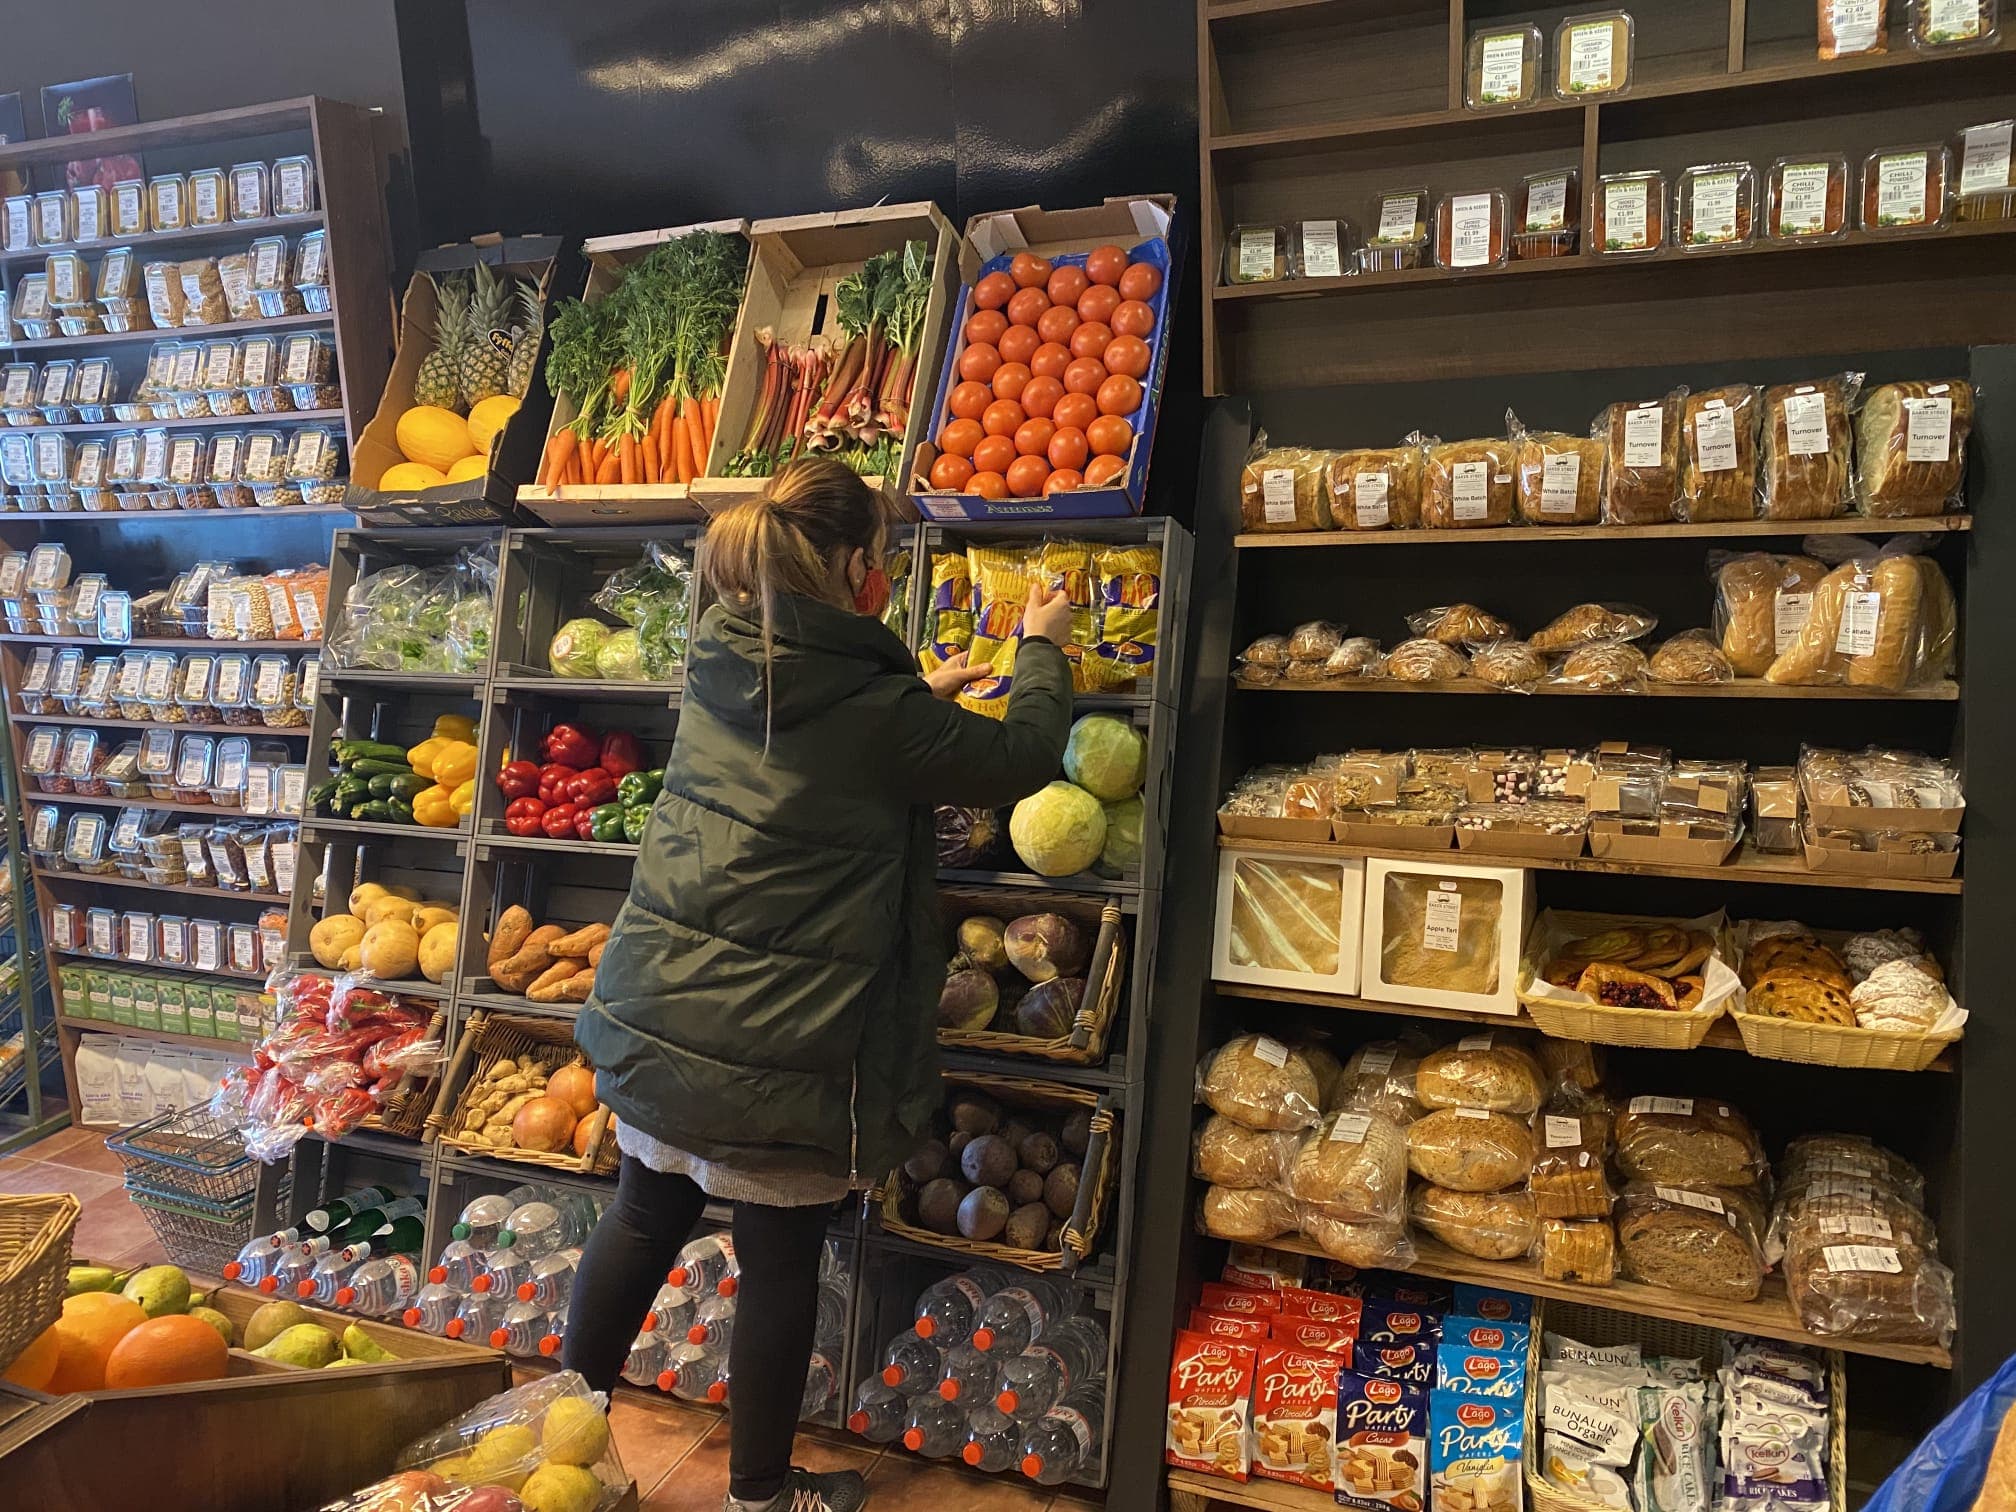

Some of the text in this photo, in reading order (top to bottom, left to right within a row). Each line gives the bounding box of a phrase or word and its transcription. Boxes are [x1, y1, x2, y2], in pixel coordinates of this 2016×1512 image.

[1791, 427, 1823, 435] Turnover
[1701, 443, 1731, 451] Turnover
[1228, 1296, 1252, 1309] Lago
[1310, 1301, 1335, 1315] Lago
[1214, 1320, 1239, 1333] Lago
[1391, 1315, 1416, 1327] Lago
[1301, 1327, 1326, 1339] Lago
[1473, 1329, 1499, 1344] Lago
[1202, 1344, 1227, 1357] Lago
[1386, 1349, 1410, 1360] Lago
[1560, 1349, 1624, 1364] BUNALUN
[1468, 1358, 1496, 1372] Lago
[1179, 1362, 1243, 1390] Party
[1264, 1373, 1328, 1402] Party
[1370, 1382, 1397, 1396] Lago
[1346, 1400, 1417, 1430] Party
[1462, 1406, 1490, 1420] Lago
[1671, 1402, 1685, 1438] kelkin
[1552, 1405, 1618, 1437] BUNALUN
[1366, 1432, 1394, 1443] Cacao
[1567, 1420, 1612, 1446] Organic
[1440, 1425, 1511, 1457] Party
[1751, 1449, 1786, 1458] kelkin
[1456, 1460, 1494, 1477] Vaniglia
[1681, 1443, 1697, 1507] RICE CAKES
